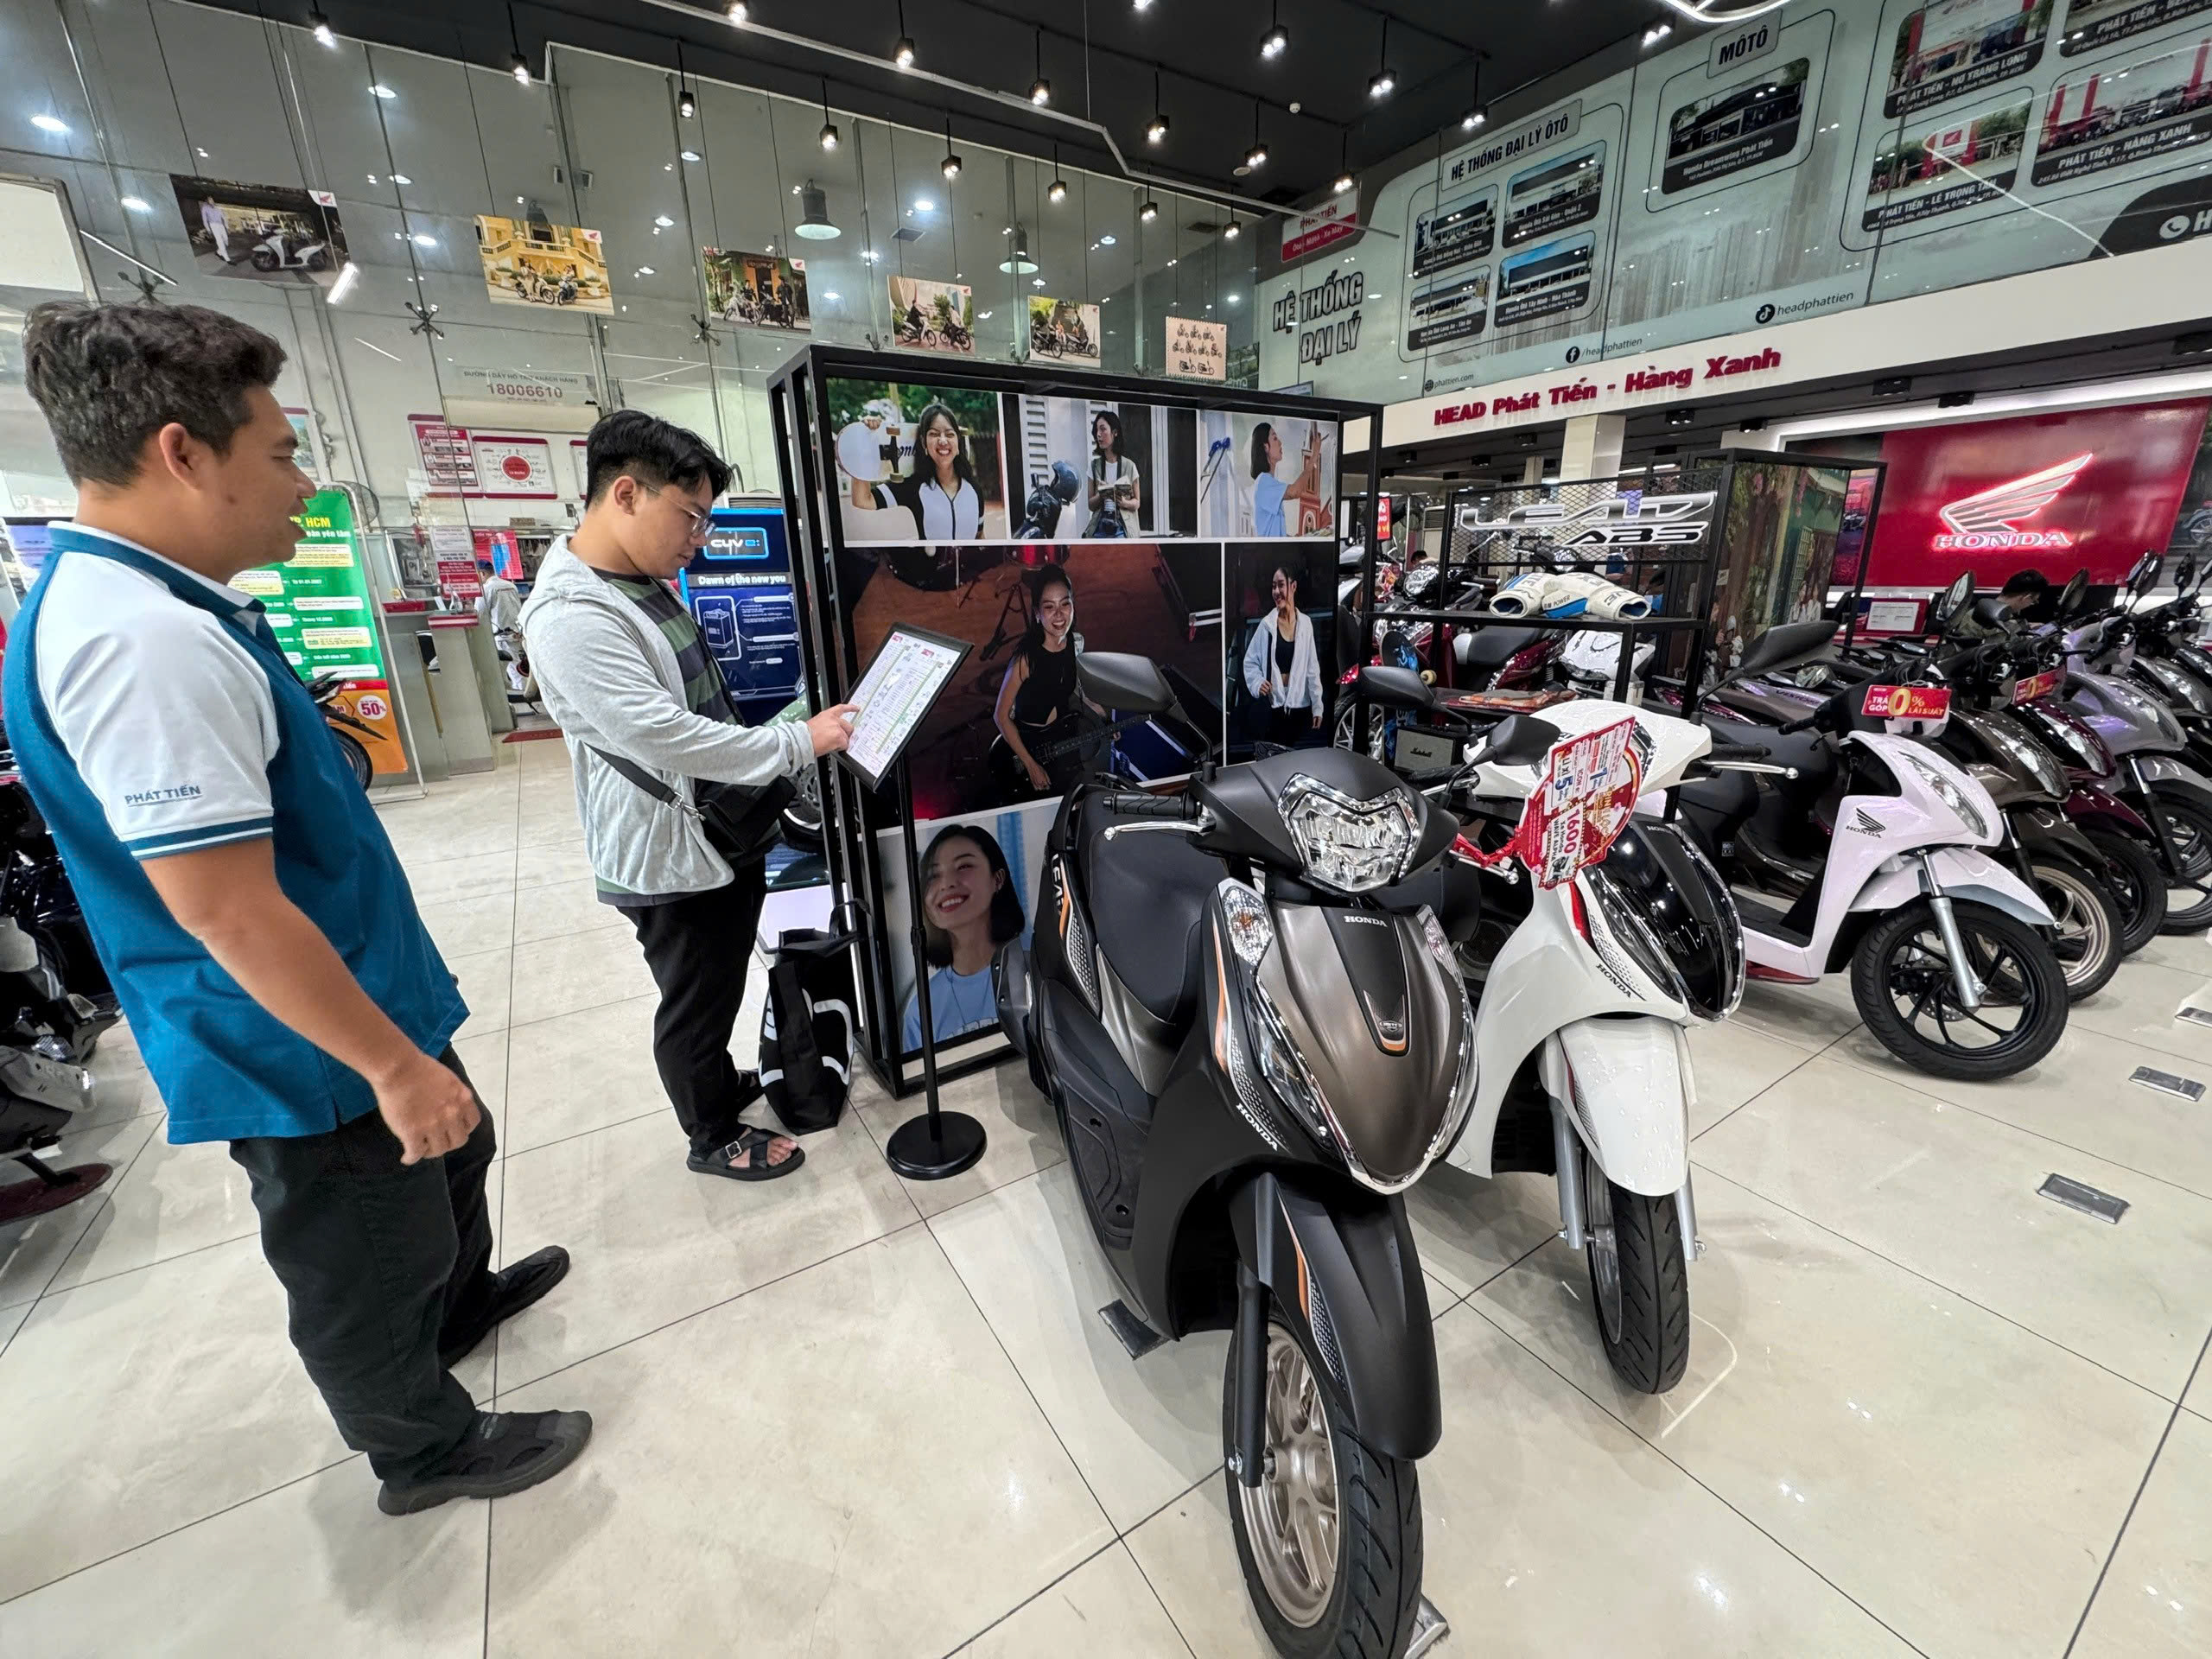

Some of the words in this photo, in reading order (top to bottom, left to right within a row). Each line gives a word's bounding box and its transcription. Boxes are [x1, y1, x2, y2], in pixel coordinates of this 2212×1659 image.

[1719, 24, 1769, 66] MÔTÔ
[1966, 61, 1999, 80] TRANG
[2000, 51, 2028, 70] LONG
[1451, 159, 1465, 181] HỆ
[1467, 146, 1503, 173] THỐNG
[1505, 135, 1524, 156] ĐẠI
[1528, 124, 1541, 147] LÝ
[1545, 113, 1568, 140] ÔTÔ
[2057, 152, 2085, 169] PHÁT
[2088, 143, 2114, 160] TIẾN
[2123, 133, 2156, 151] HÀNG
[2158, 123, 2192, 143] XANH
[1904, 200, 1923, 213] TIẾN
[1273, 290, 1296, 334] HỆ
[1300, 270, 1363, 323] THỐNG
[1777, 290, 1853, 317] headphattien
[1300, 325, 1333, 365] ĐẠI
[1336, 309, 1362, 354] LÝ
[1581, 337, 1643, 358] /headphattien
[486, 383, 563, 398] 18006610
[1433, 400, 1487, 426] HEAD
[1492, 391, 1541, 416] Phát
[1548, 378, 1597, 405] Tiến
[1624, 365, 1694, 393] Hàng
[1703, 347, 1782, 378] Xanh
[305, 517, 331, 528] HCM
[1460, 492, 1718, 531] LEAD
[1561, 521, 1709, 546] ABS
[1935, 532, 2073, 550] HONDA
[698, 575, 724, 585] Dawn
[725, 574, 735, 586] of
[736, 574, 750, 584] the
[771, 575, 786, 585] you
[1868, 702, 1888, 711] GÓP
[1555, 775, 1573, 790] 5
[1575, 768, 1584, 786] ICON
[124, 790, 162, 804] PHÁT
[163, 785, 201, 799] TIẾN
[1564, 809, 1580, 854] 1600
[1846, 825, 1882, 838] HONDA
[1344, 915, 1388, 927] HONDA
[1596, 963, 1632, 1000] HONDA
[1236, 1103, 1278, 1152] HONDA
